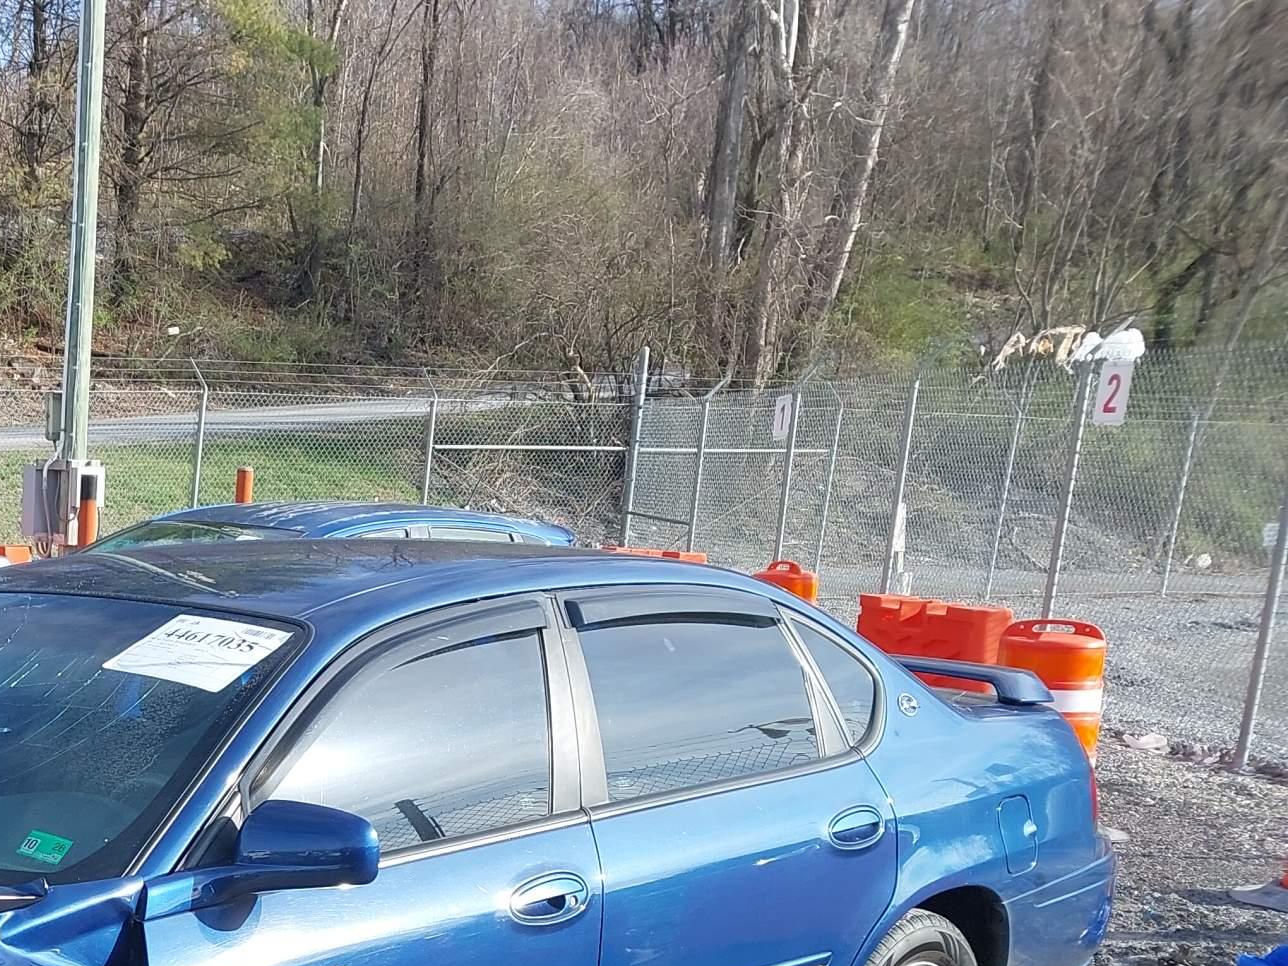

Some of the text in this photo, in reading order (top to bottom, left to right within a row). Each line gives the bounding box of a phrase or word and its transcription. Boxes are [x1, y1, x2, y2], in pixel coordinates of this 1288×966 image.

[1103, 373, 1121, 413] 2
[780, 403, 786, 431] 1
[165, 628, 258, 653] 44617035
[23, 838, 38, 849] 10
